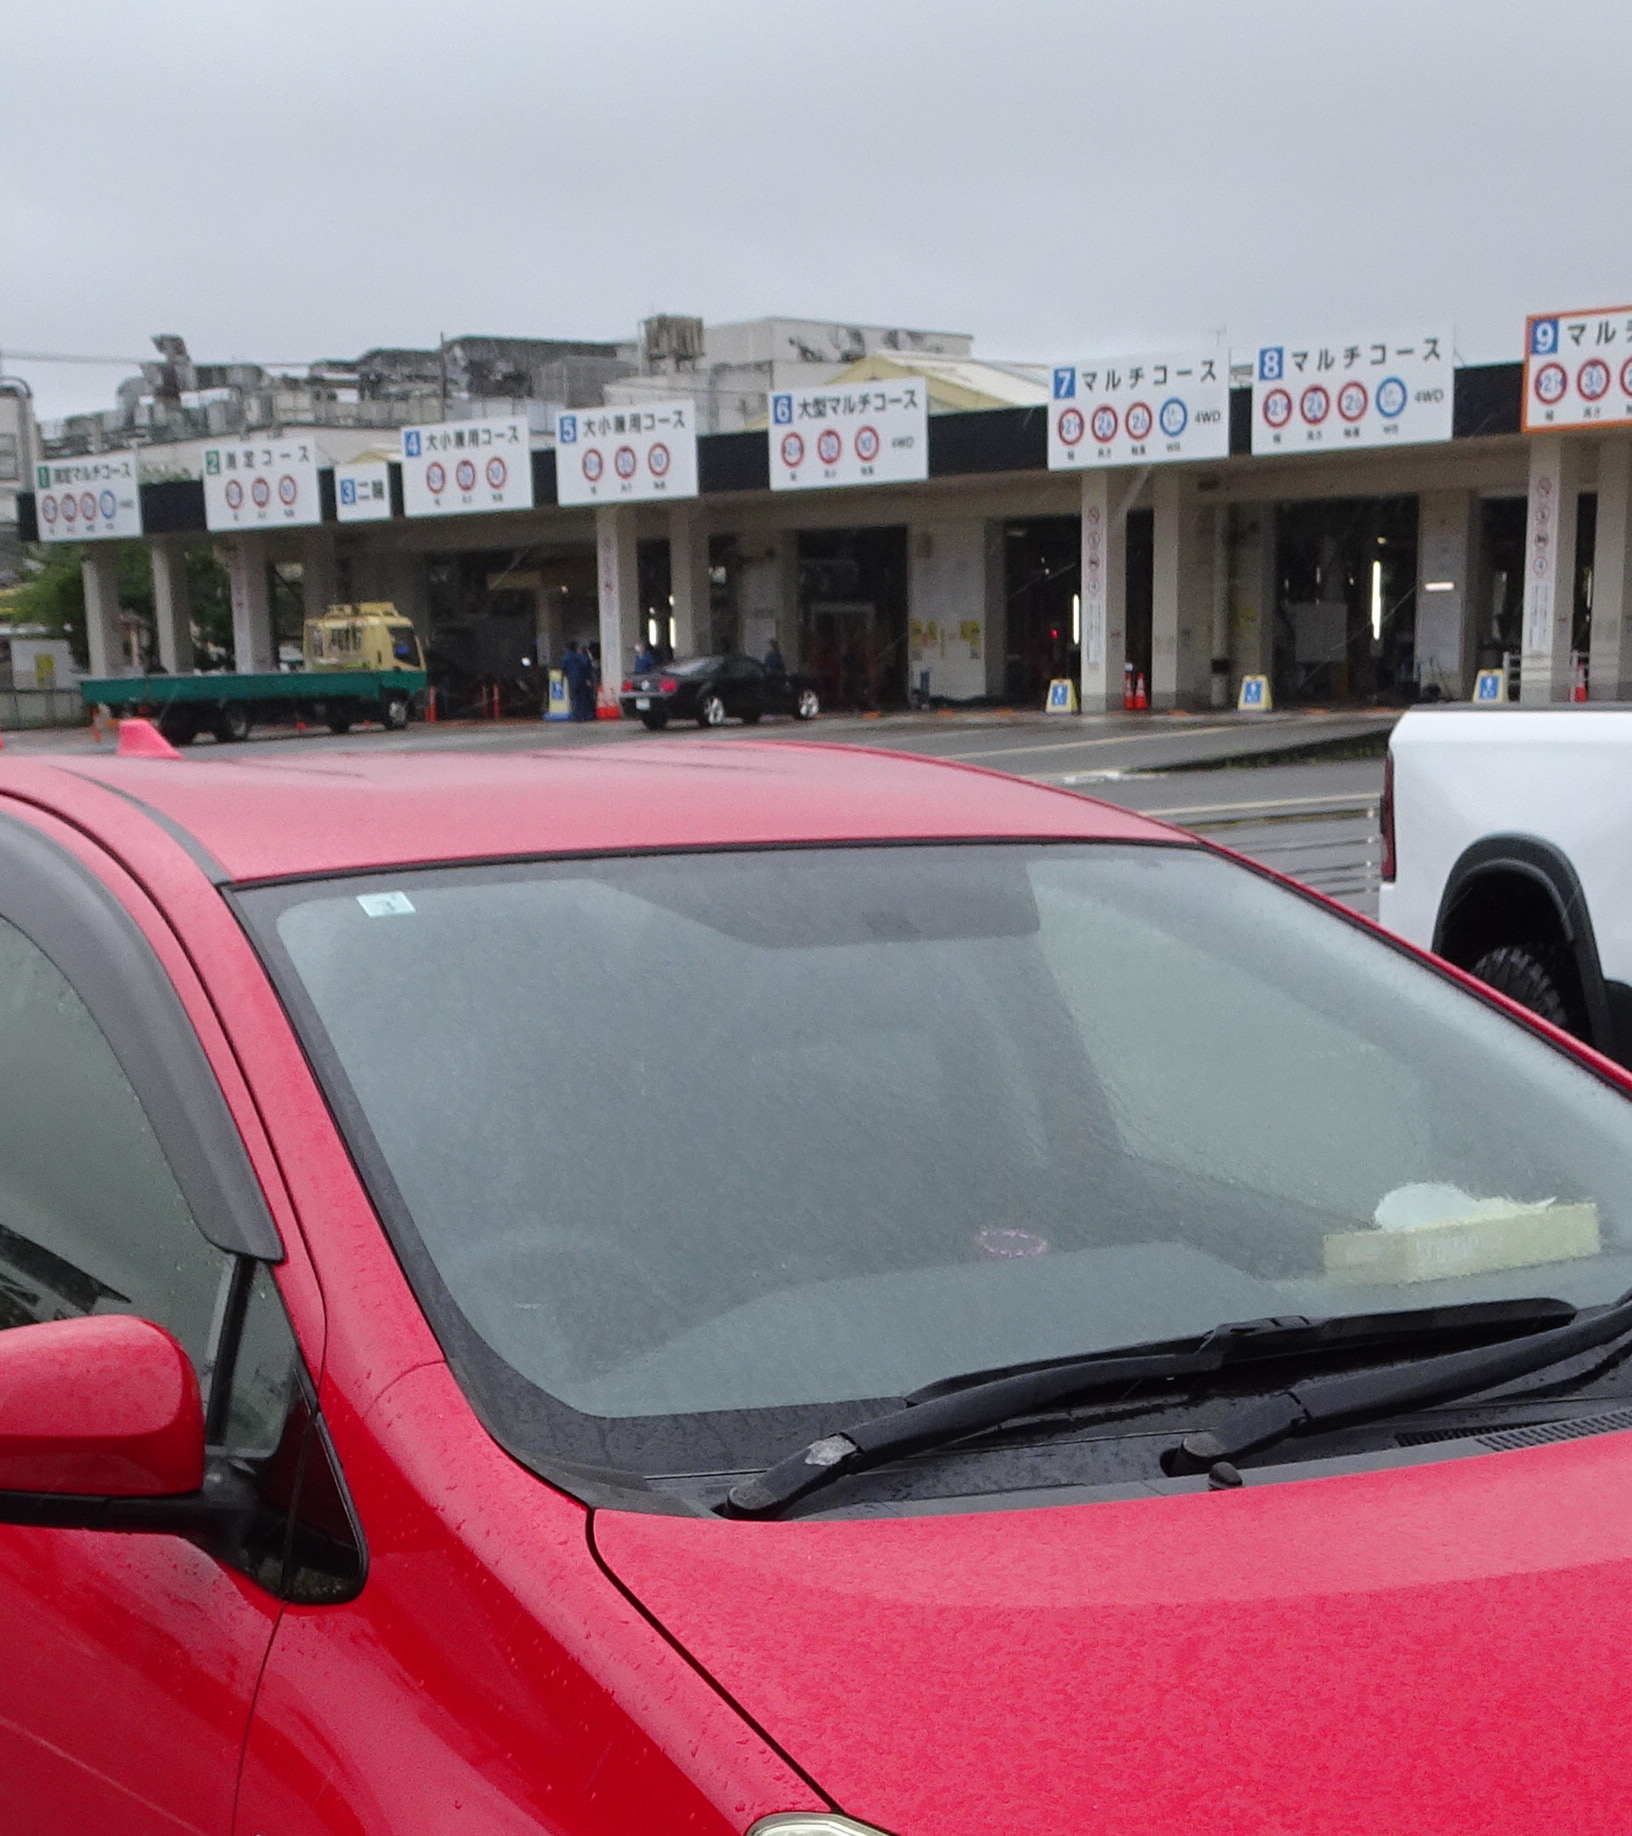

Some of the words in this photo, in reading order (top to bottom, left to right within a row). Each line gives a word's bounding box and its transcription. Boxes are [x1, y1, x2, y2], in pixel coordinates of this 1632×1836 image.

[1535, 321, 1555, 354] 9
[1262, 348, 1280, 379] 8
[1291, 336, 1441, 373] マルチコース
[1057, 369, 1072, 398] 7
[1082, 358, 1217, 392] マルチコース
[775, 397, 790, 423] 6
[797, 388, 919, 420] 大型マルチコース
[1194, 408, 1222, 424] 4WD
[406, 430, 420, 456] 4
[561, 416, 575, 442] 5
[341, 479, 355, 504] 3
